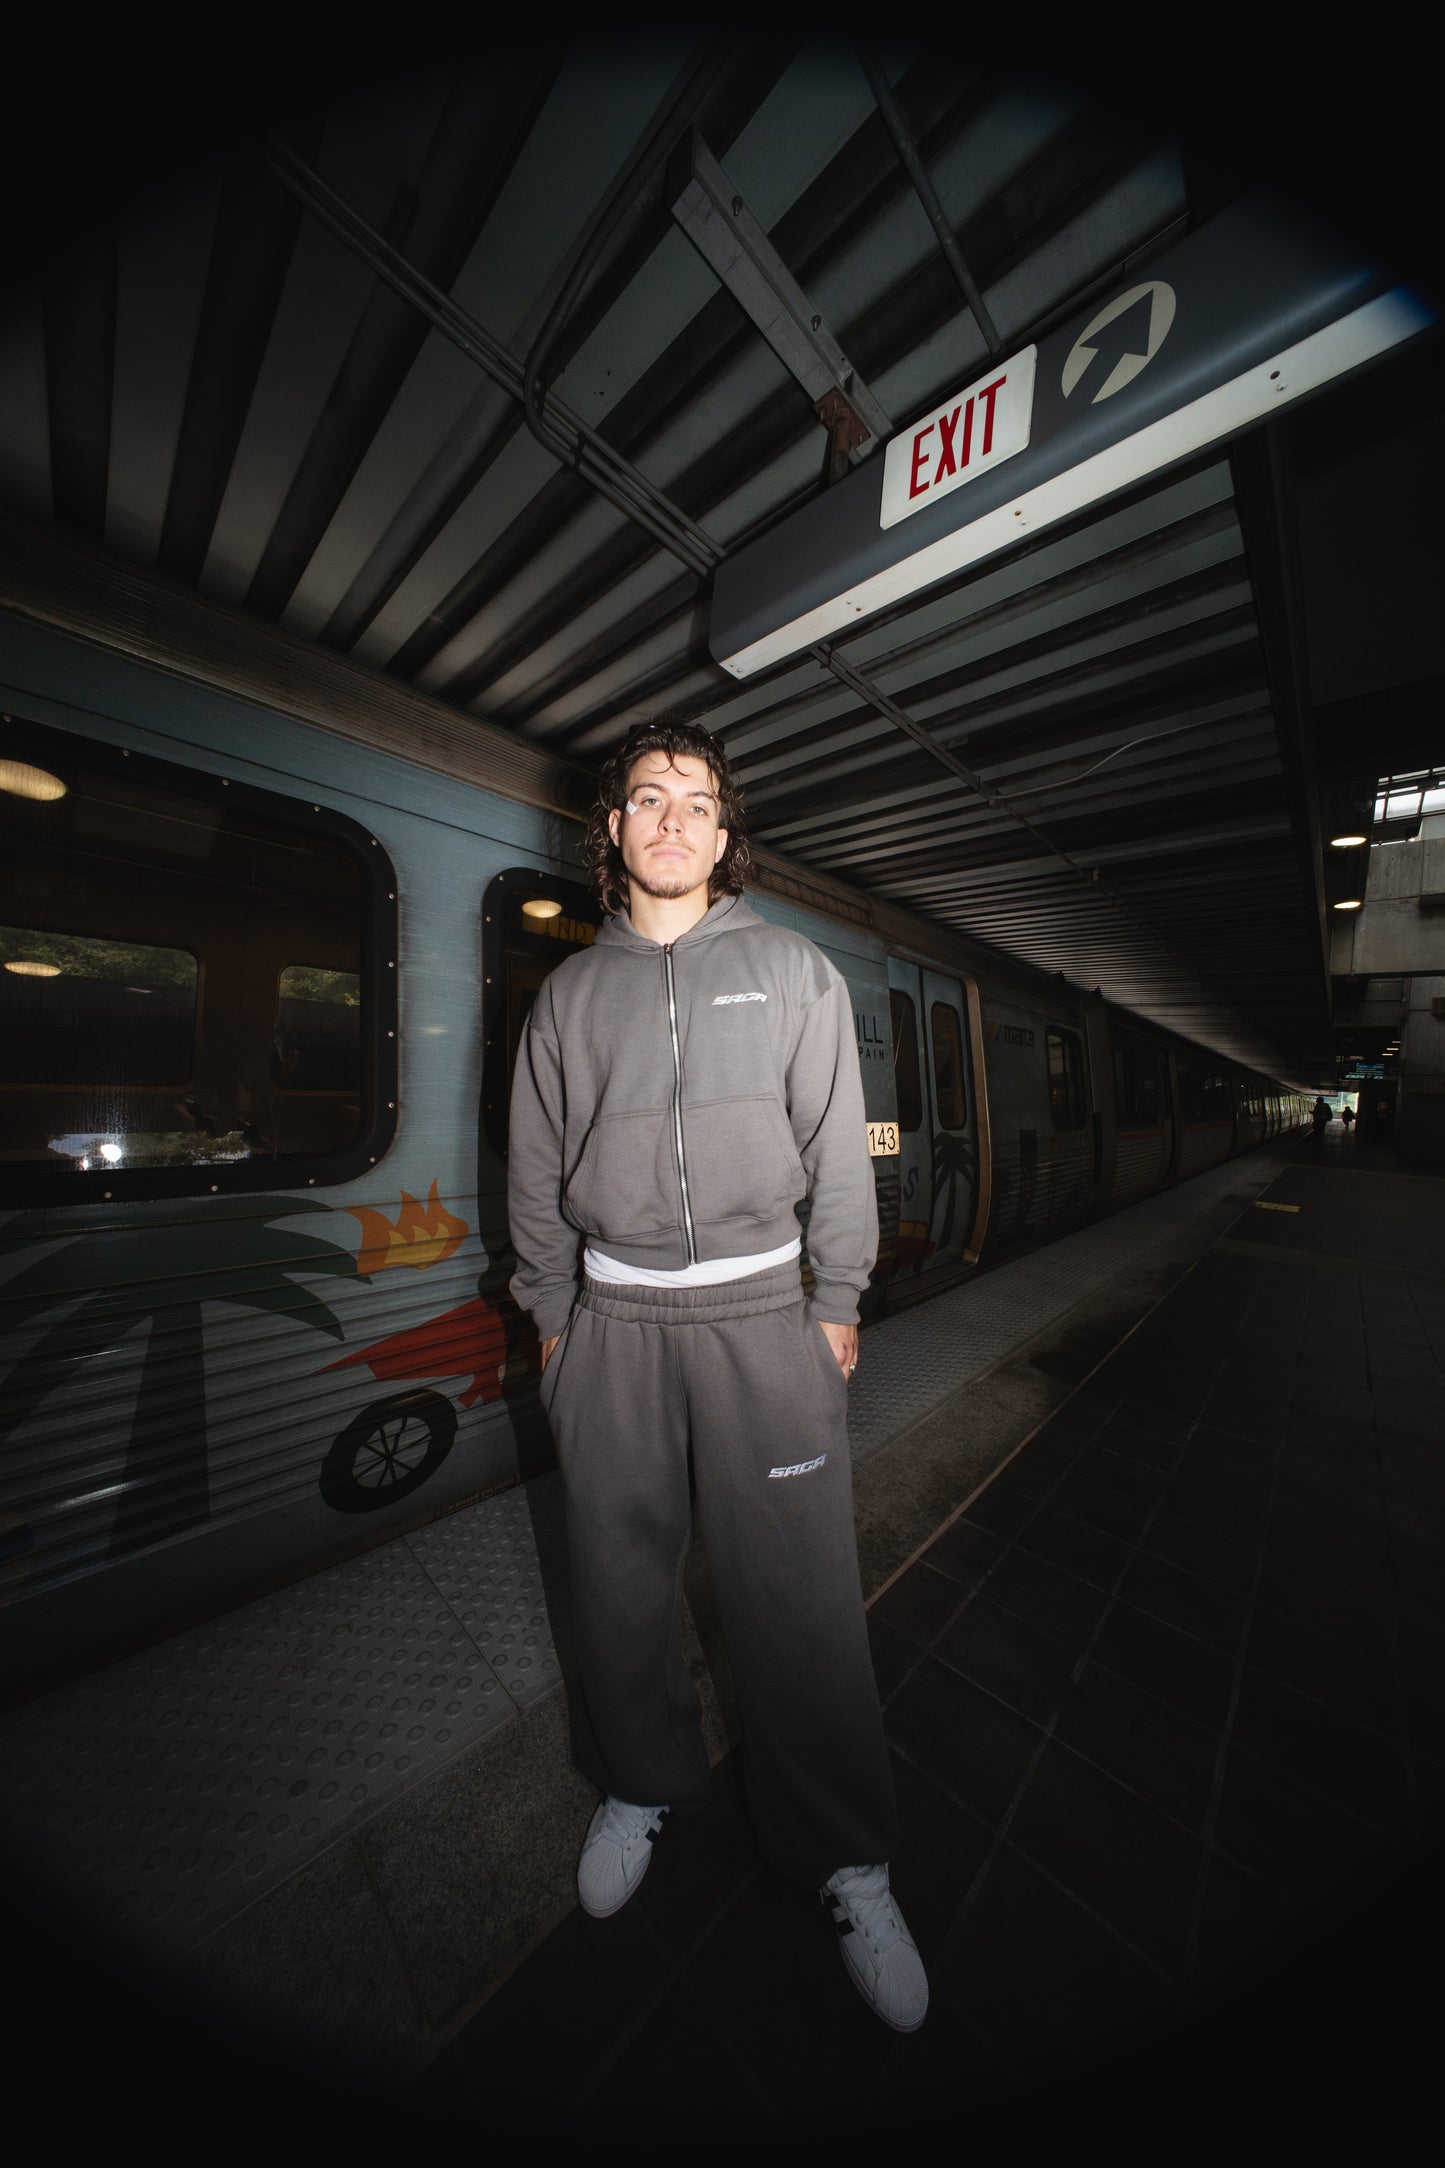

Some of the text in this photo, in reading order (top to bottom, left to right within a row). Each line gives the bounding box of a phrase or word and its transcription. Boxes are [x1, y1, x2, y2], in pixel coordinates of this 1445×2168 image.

[909, 375, 1006, 500] EXIT
[858, 1046, 885, 1061] PAIN
[869, 1126, 896, 1151] 143
[767, 1453, 827, 1478] SAGA
